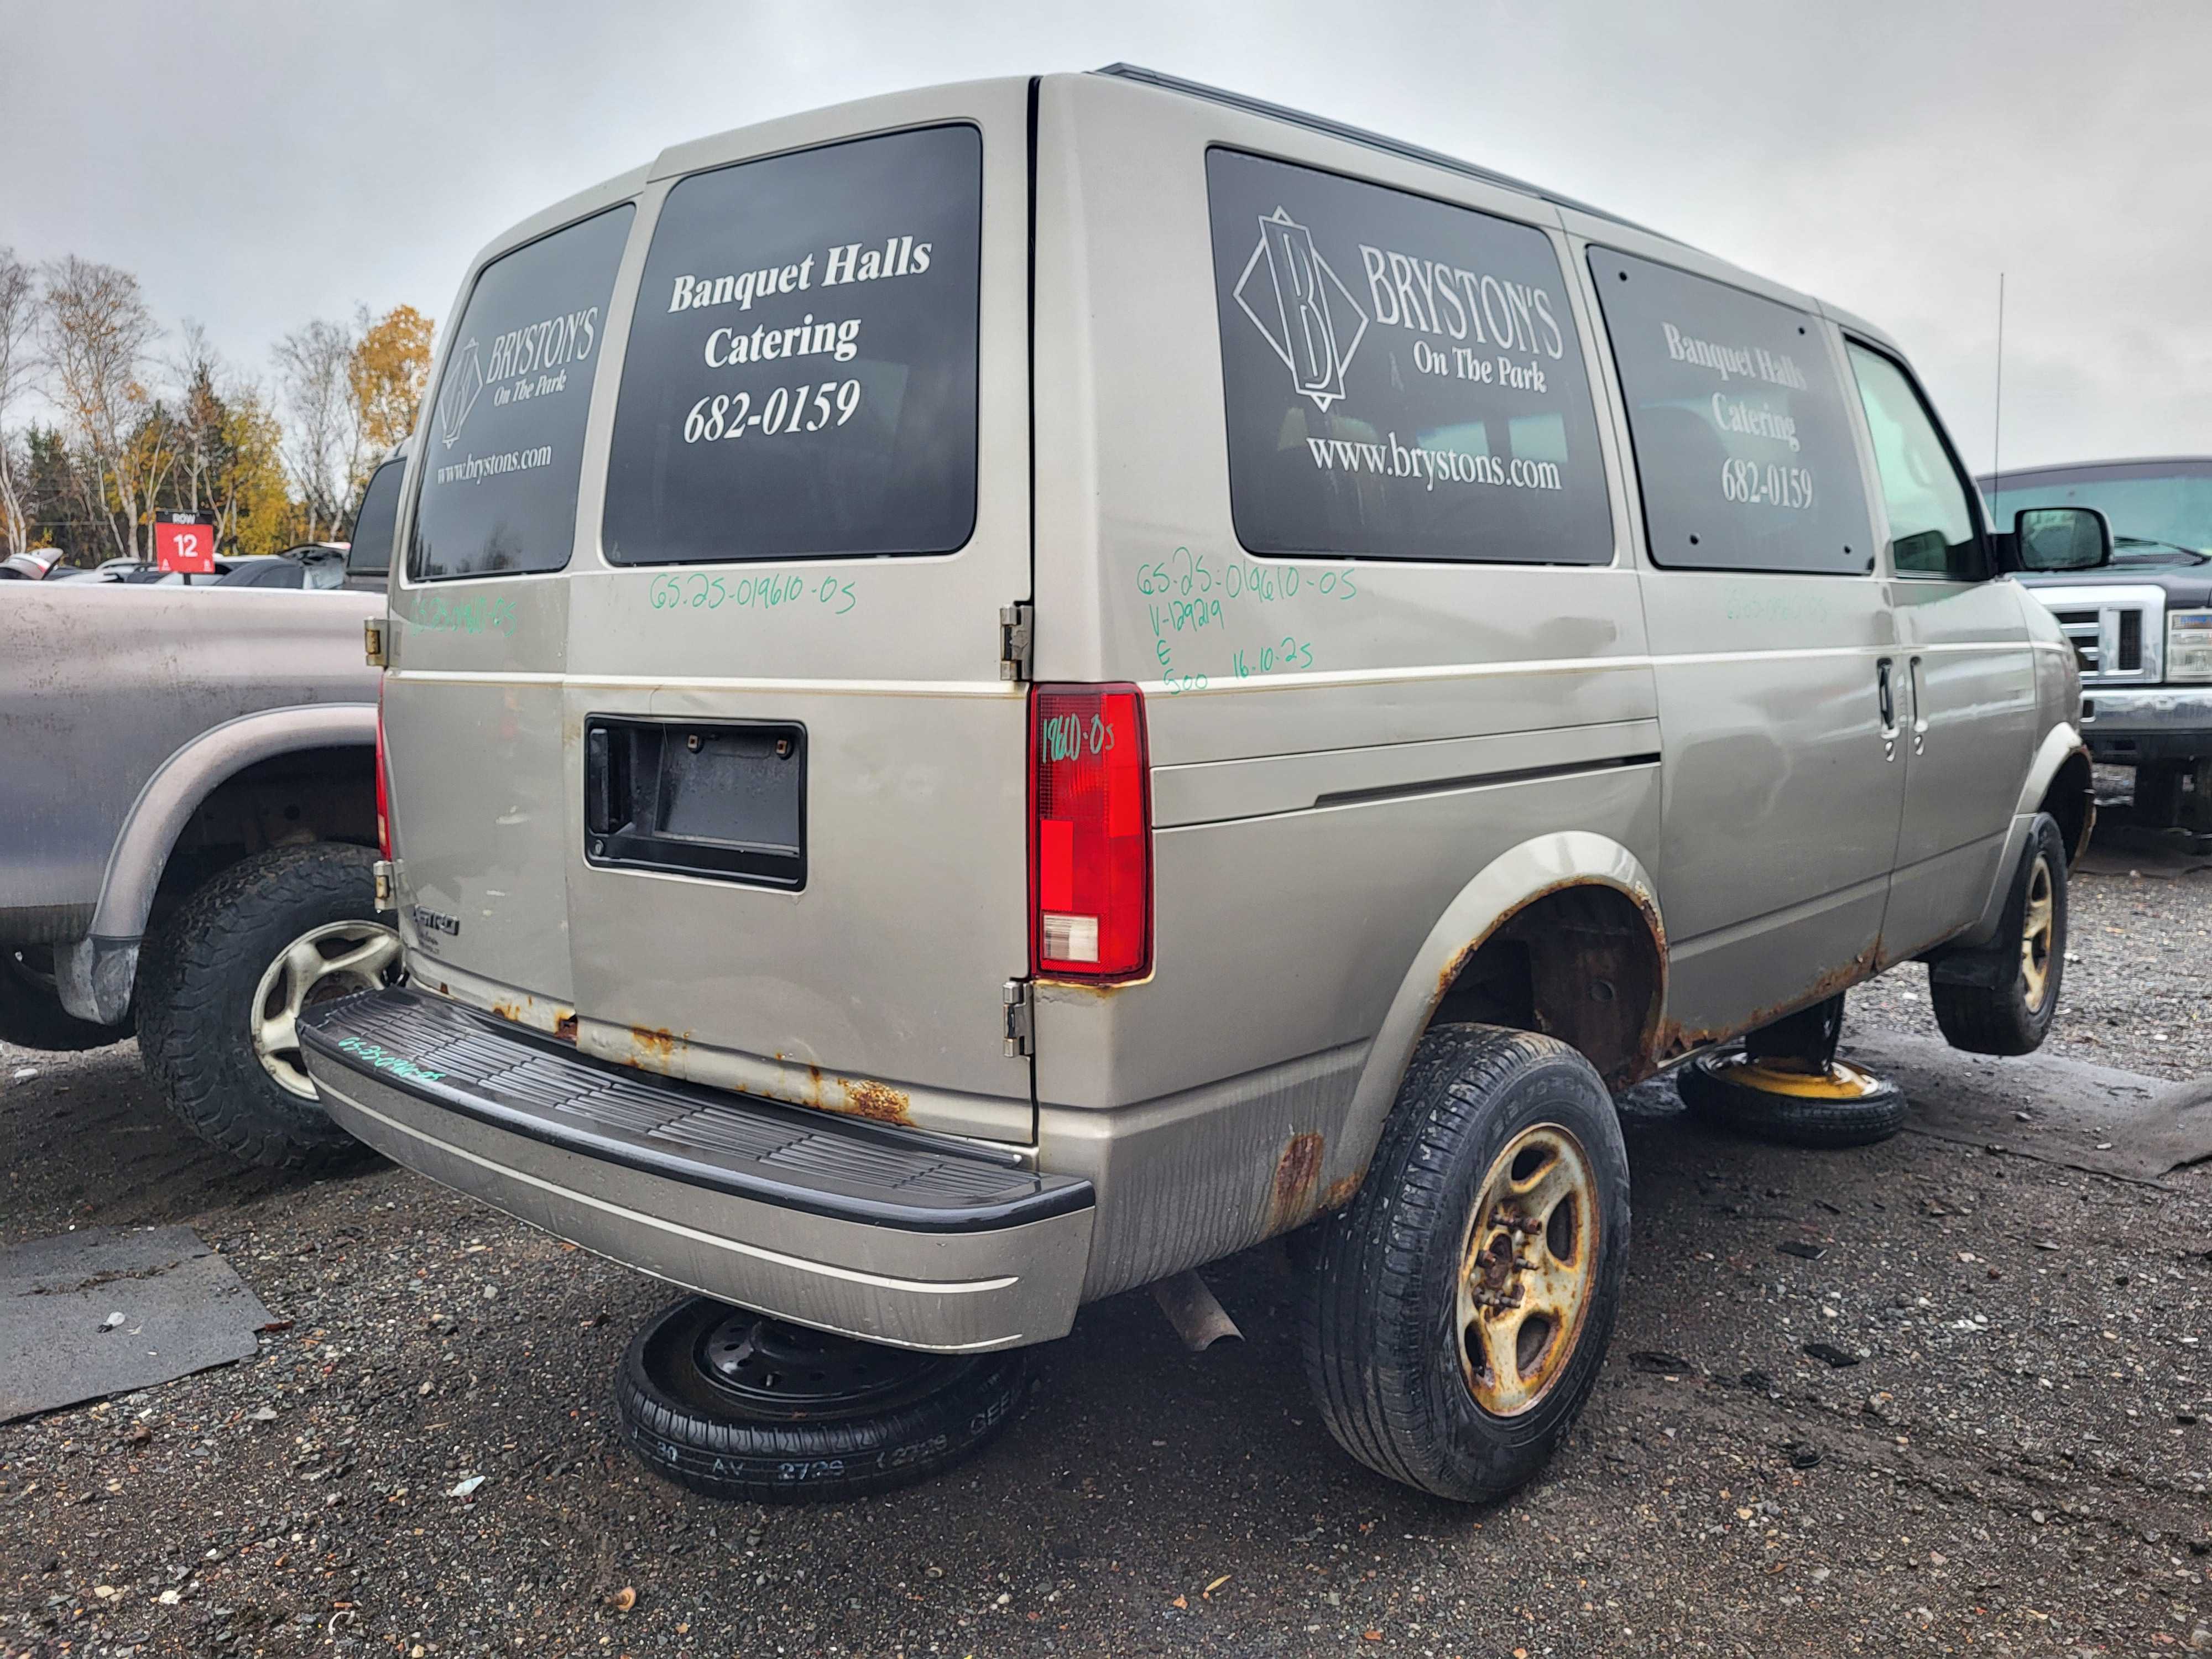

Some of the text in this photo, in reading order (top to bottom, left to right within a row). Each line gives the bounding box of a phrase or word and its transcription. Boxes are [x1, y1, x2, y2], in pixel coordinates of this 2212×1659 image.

[667, 235, 932, 314] Banquet Halls
[1359, 244, 1563, 361] BRYSTON'S
[486, 307, 598, 384] BRYSTON'S
[704, 314, 861, 368] Catering
[1413, 340, 1547, 393] On The Park
[1662, 322, 1807, 390] Banquet Halls
[494, 368, 566, 406] On The Park
[683, 379, 860, 443] 682-0159
[1712, 393, 1800, 452] Catering
[438, 445, 552, 484] www.brystons.com
[1307, 431, 1562, 491] www.brystons.com
[1722, 458, 1812, 509] 682-0159
[173, 513, 195, 524] ROW
[173, 534, 199, 557] 12
